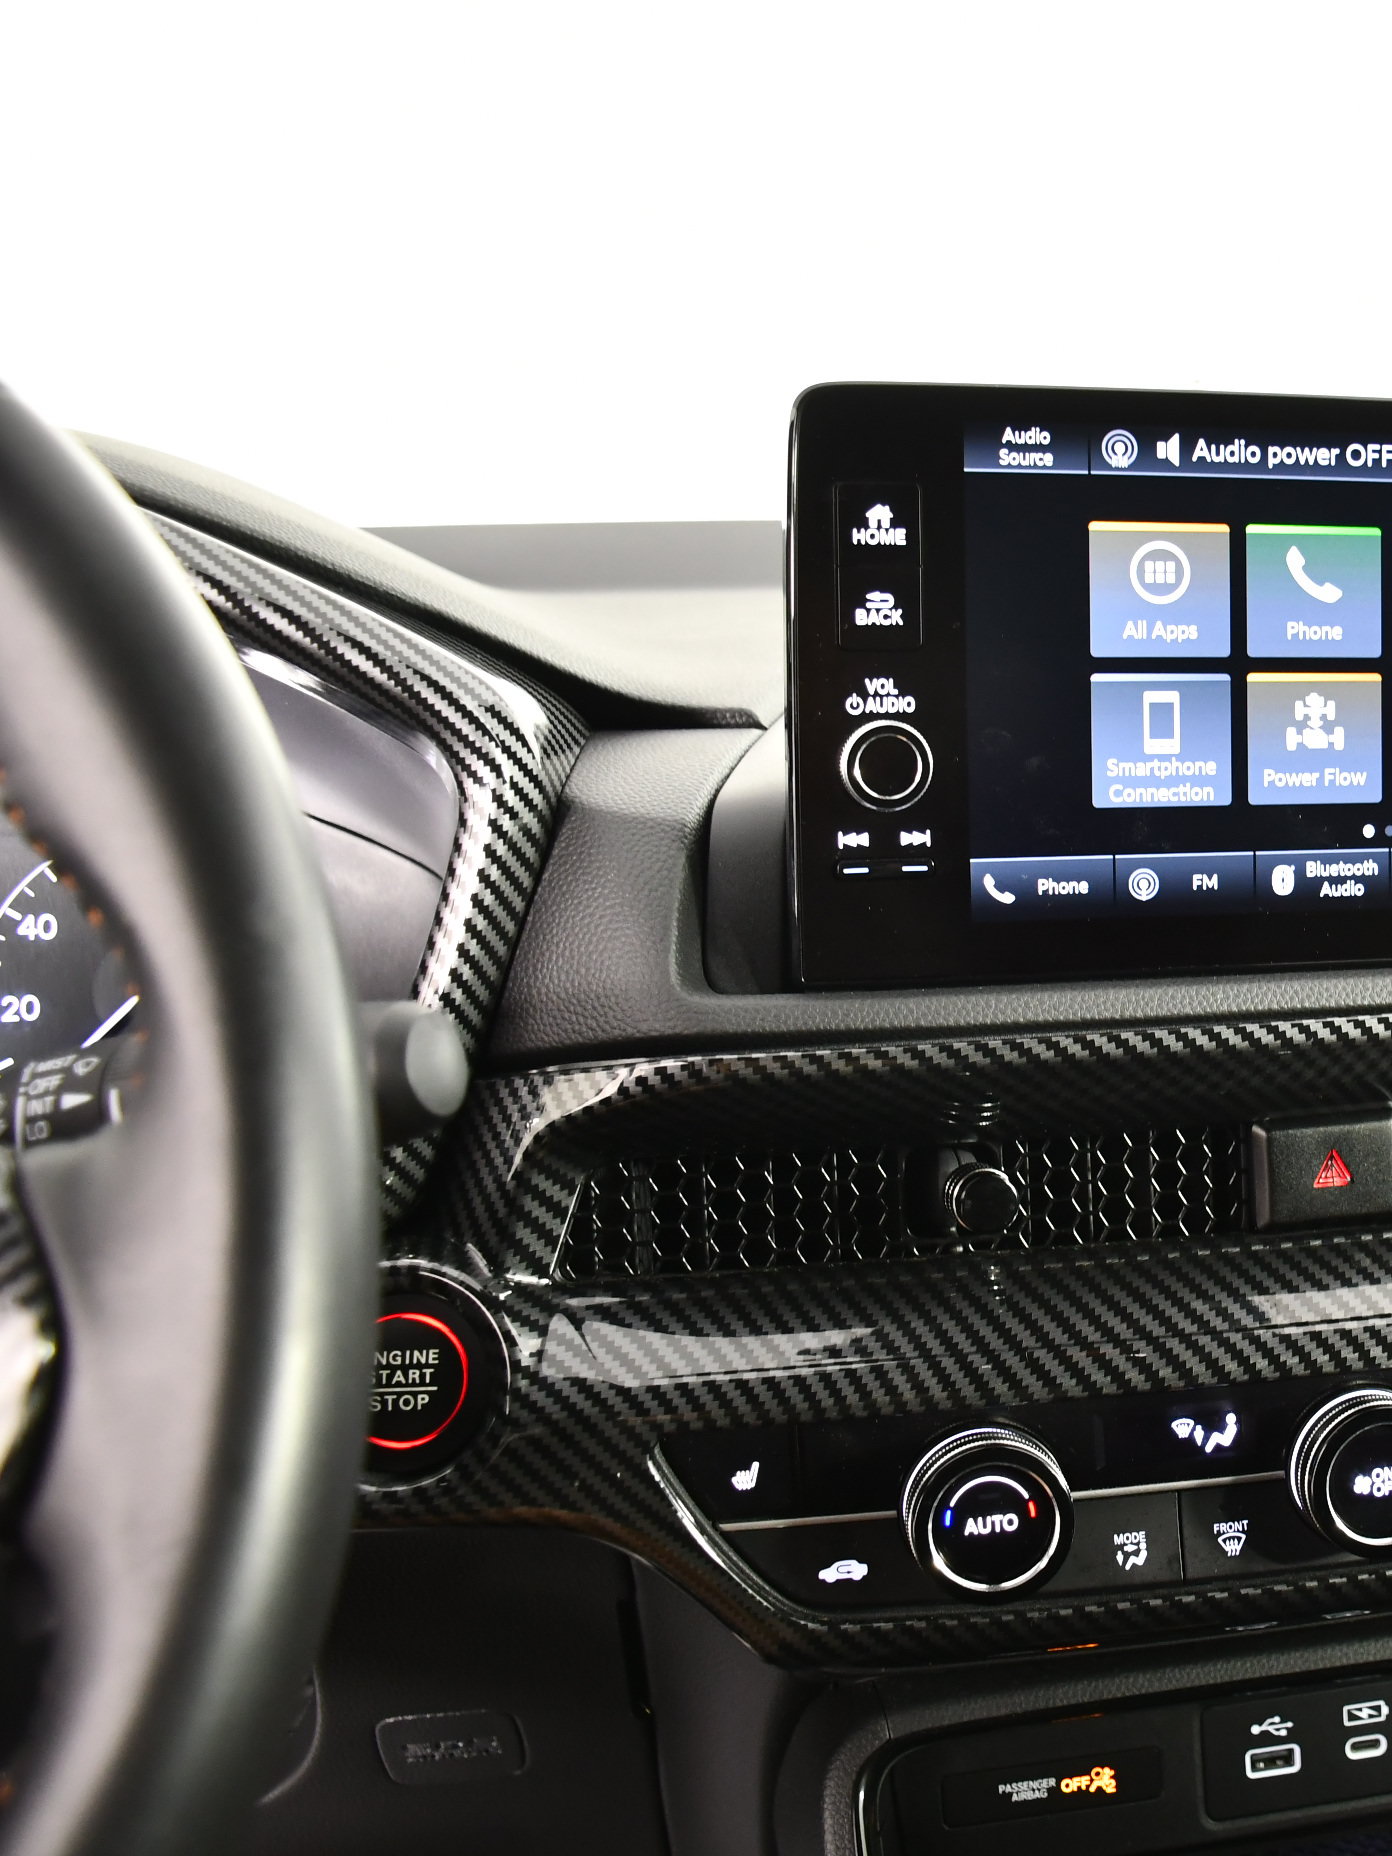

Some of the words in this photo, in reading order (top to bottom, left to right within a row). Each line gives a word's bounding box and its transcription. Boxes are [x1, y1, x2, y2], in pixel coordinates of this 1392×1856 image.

[1001, 426, 1051, 446] Audio
[998, 447, 1054, 467] Source
[1191, 437, 1262, 464] Audio
[1267, 444, 1341, 471] power
[852, 526, 907, 546] HOME
[855, 608, 904, 626] BACK
[1122, 619, 1148, 640] All
[1151, 620, 1198, 643] Apps
[1286, 621, 1343, 641] Phone
[865, 678, 898, 695] VOL
[865, 696, 916, 714] AUDIO
[1106, 758, 1217, 783] Smartphone
[1263, 768, 1321, 788] Power
[1324, 767, 1367, 787] Flow
[1108, 782, 1215, 803] Connection
[1305, 858, 1379, 878] Bluetooth
[1037, 877, 1090, 896] Phone
[1192, 873, 1219, 891] FM
[1319, 879, 1366, 898] Audio
[17, 911, 58, 941] 40
[0, 993, 41, 1023] 20
[26, 1120, 50, 1141] LO
[373, 1349, 440, 1366] NGINE
[963, 1512, 1019, 1537] AUTO
[1213, 1519, 1249, 1535] FRONT
[1113, 1530, 1148, 1546] MODE
[998, 1777, 1056, 1794] PASSENGER
[1060, 1775, 1091, 1793] OFF
[1011, 1788, 1048, 1802] AIRBAG
